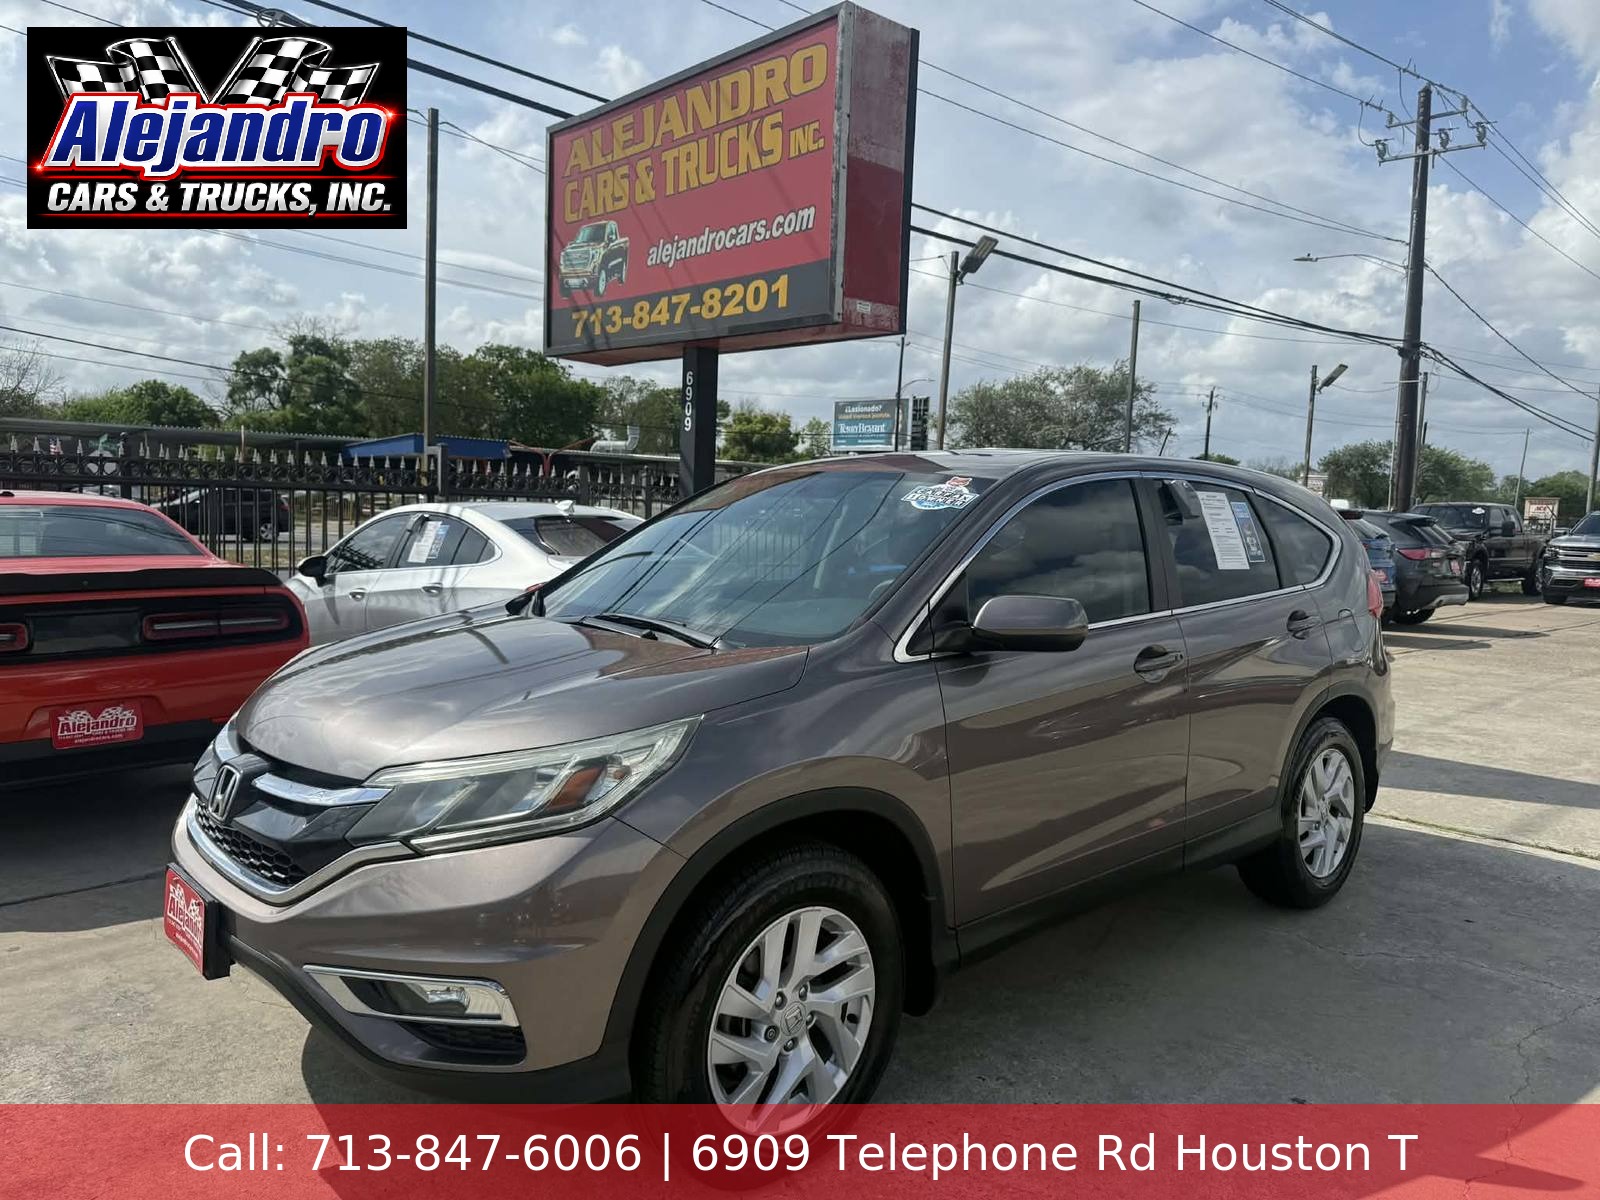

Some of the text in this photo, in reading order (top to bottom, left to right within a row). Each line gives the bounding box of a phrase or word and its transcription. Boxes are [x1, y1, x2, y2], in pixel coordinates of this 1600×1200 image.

[562, 43, 828, 177] ALEJANDRO
[562, 110, 826, 224] CARS & TRUCKS INC.
[646, 205, 816, 268] alejandrocars.com
[571, 274, 789, 338] 713-847-8201
[58, 716, 137, 735] Alejandro
